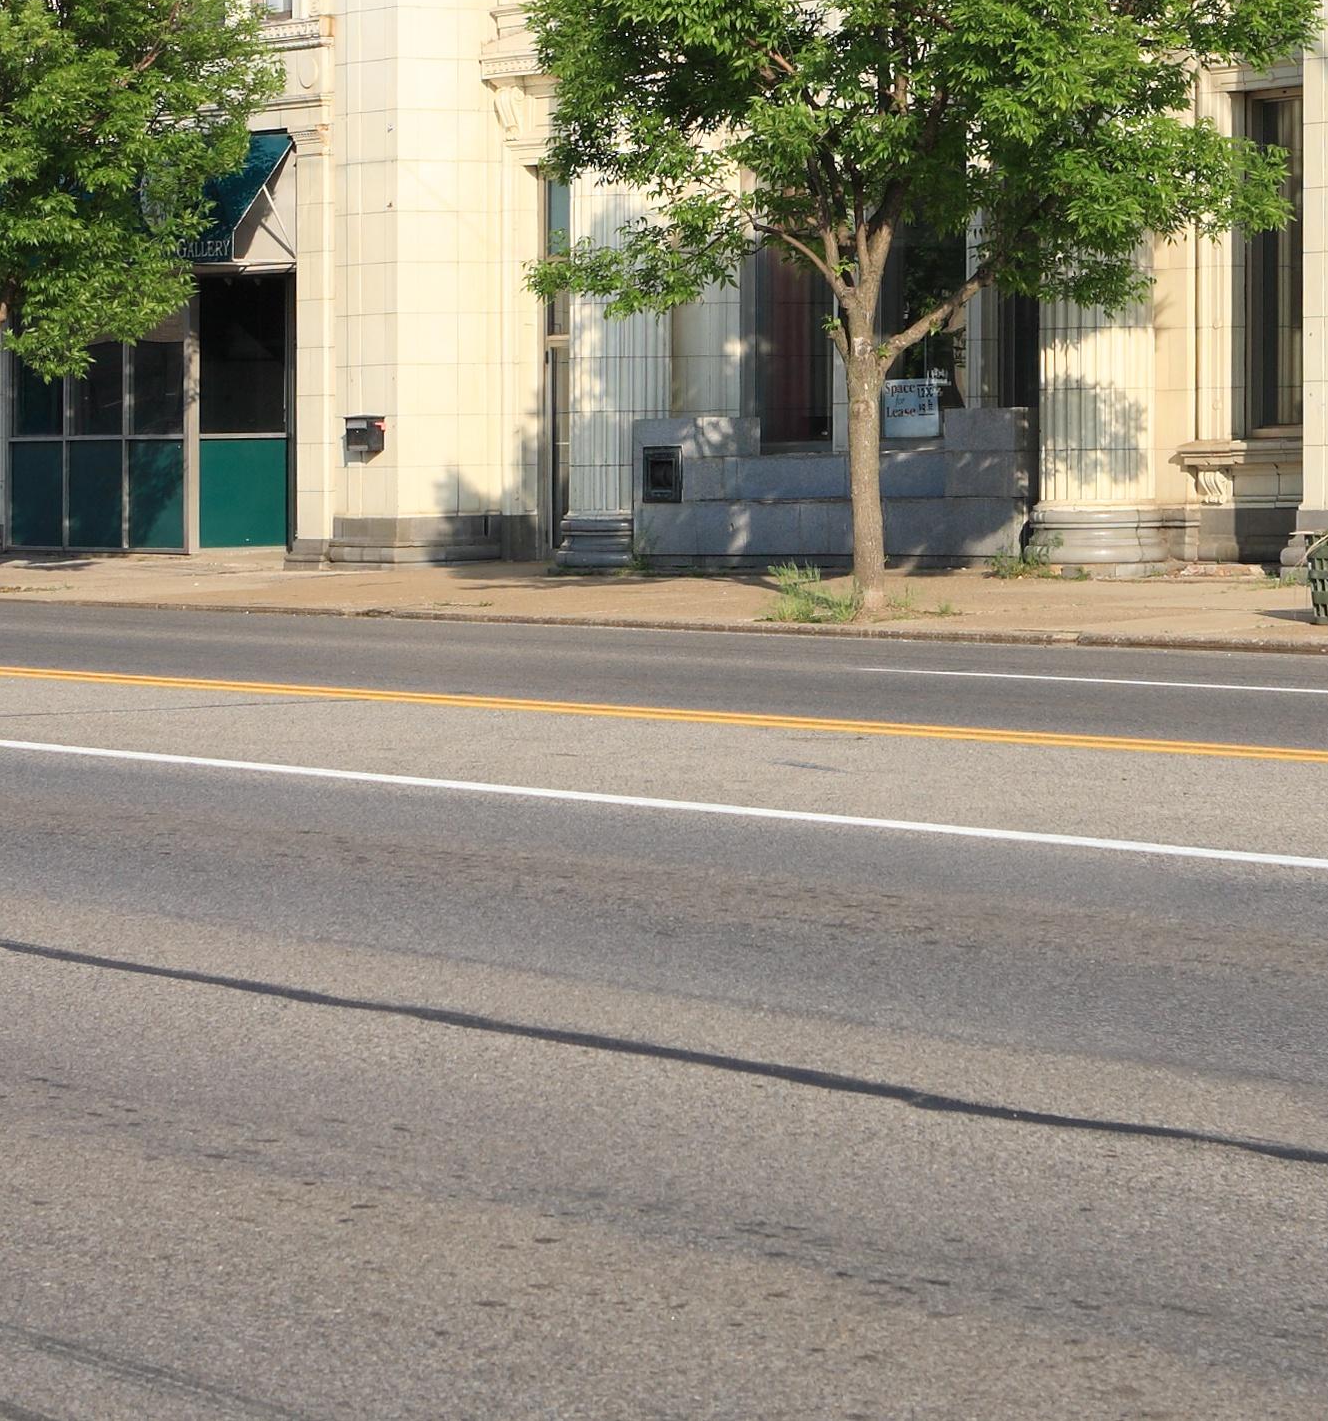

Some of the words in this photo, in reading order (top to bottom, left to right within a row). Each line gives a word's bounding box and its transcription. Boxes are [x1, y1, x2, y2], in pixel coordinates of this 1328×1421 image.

[177, 239, 230, 258] GALLERY
[885, 383, 916, 396] Space
[886, 406, 917, 418] Lease
